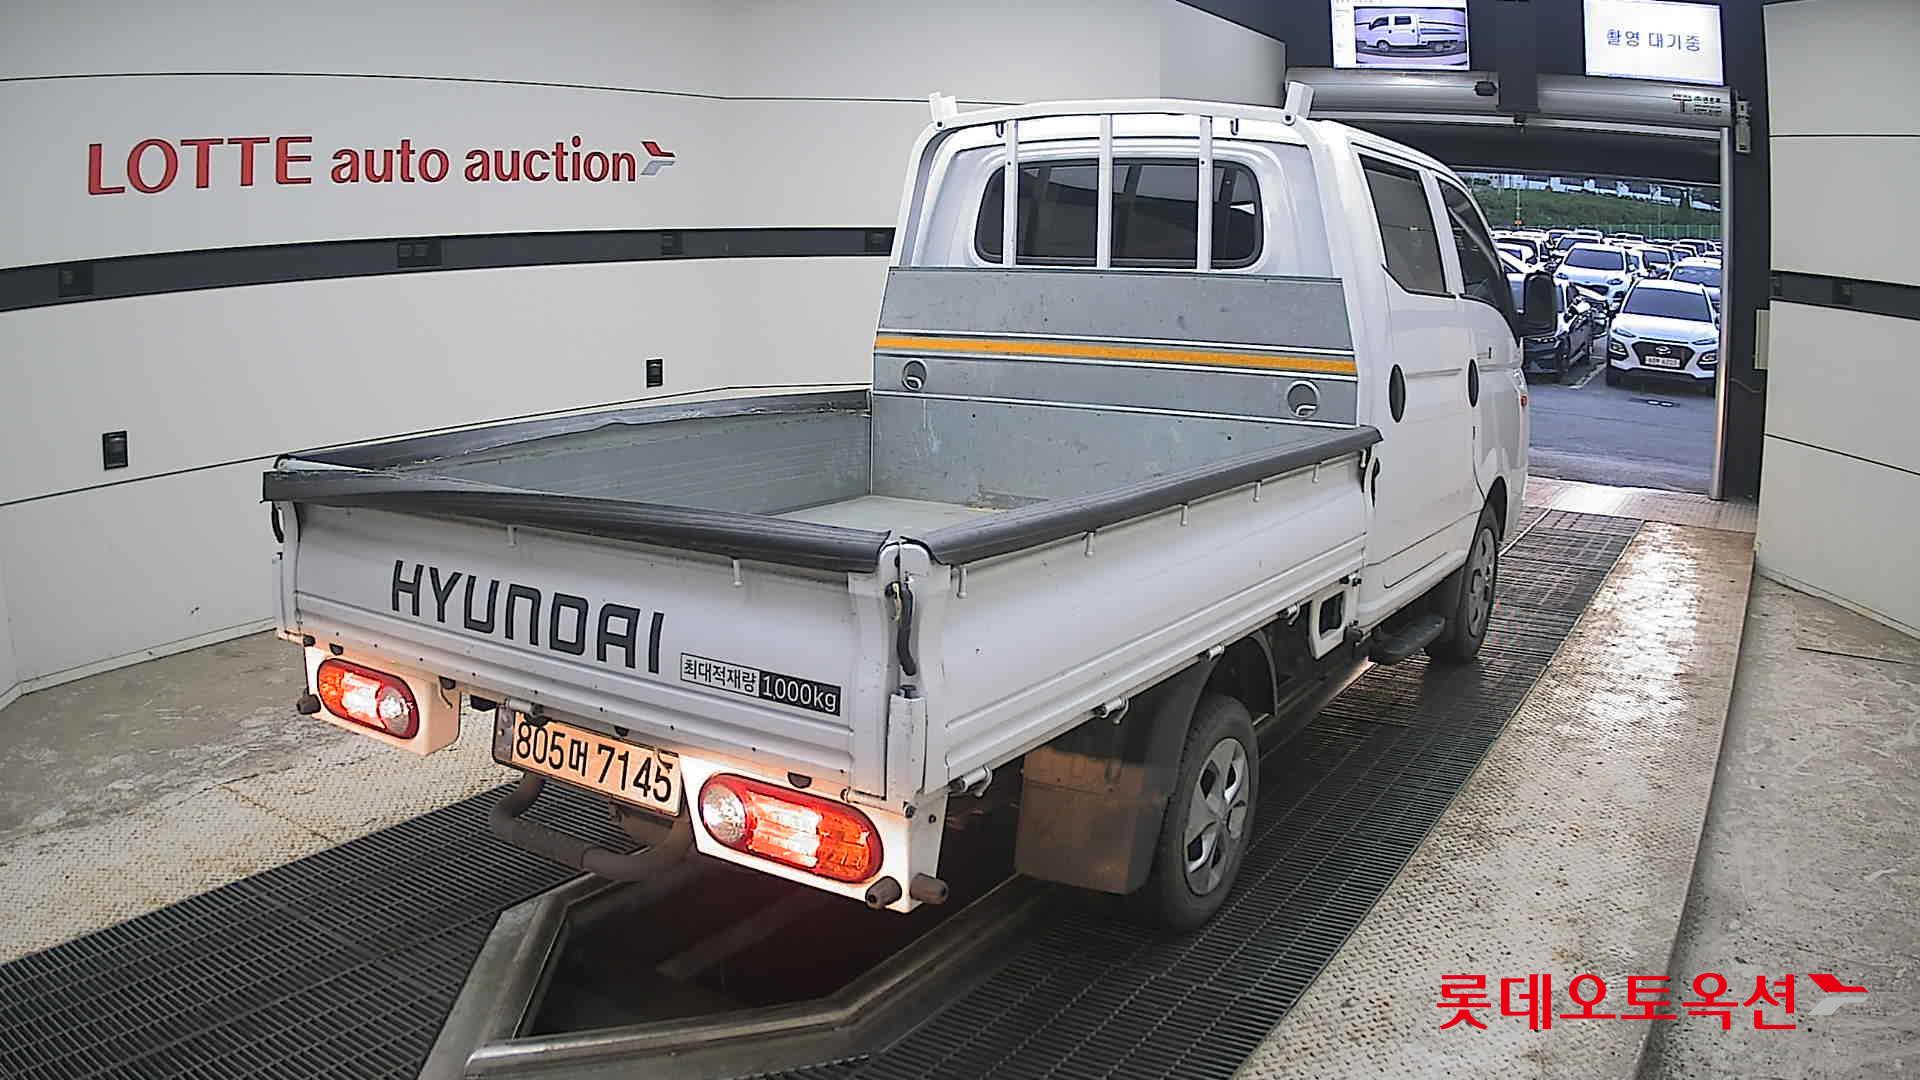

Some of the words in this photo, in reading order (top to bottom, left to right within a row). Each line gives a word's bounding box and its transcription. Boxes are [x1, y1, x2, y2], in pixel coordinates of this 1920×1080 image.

[1648, 32, 1701, 52] 대기중
[88, 136, 313, 196] LOTTE
[330, 138, 450, 184] auto
[463, 135, 638, 183] auction
[391, 559, 665, 675] HYUNDAI
[684, 659, 757, 693] 최대적재량
[597, 743, 673, 803] 7145
